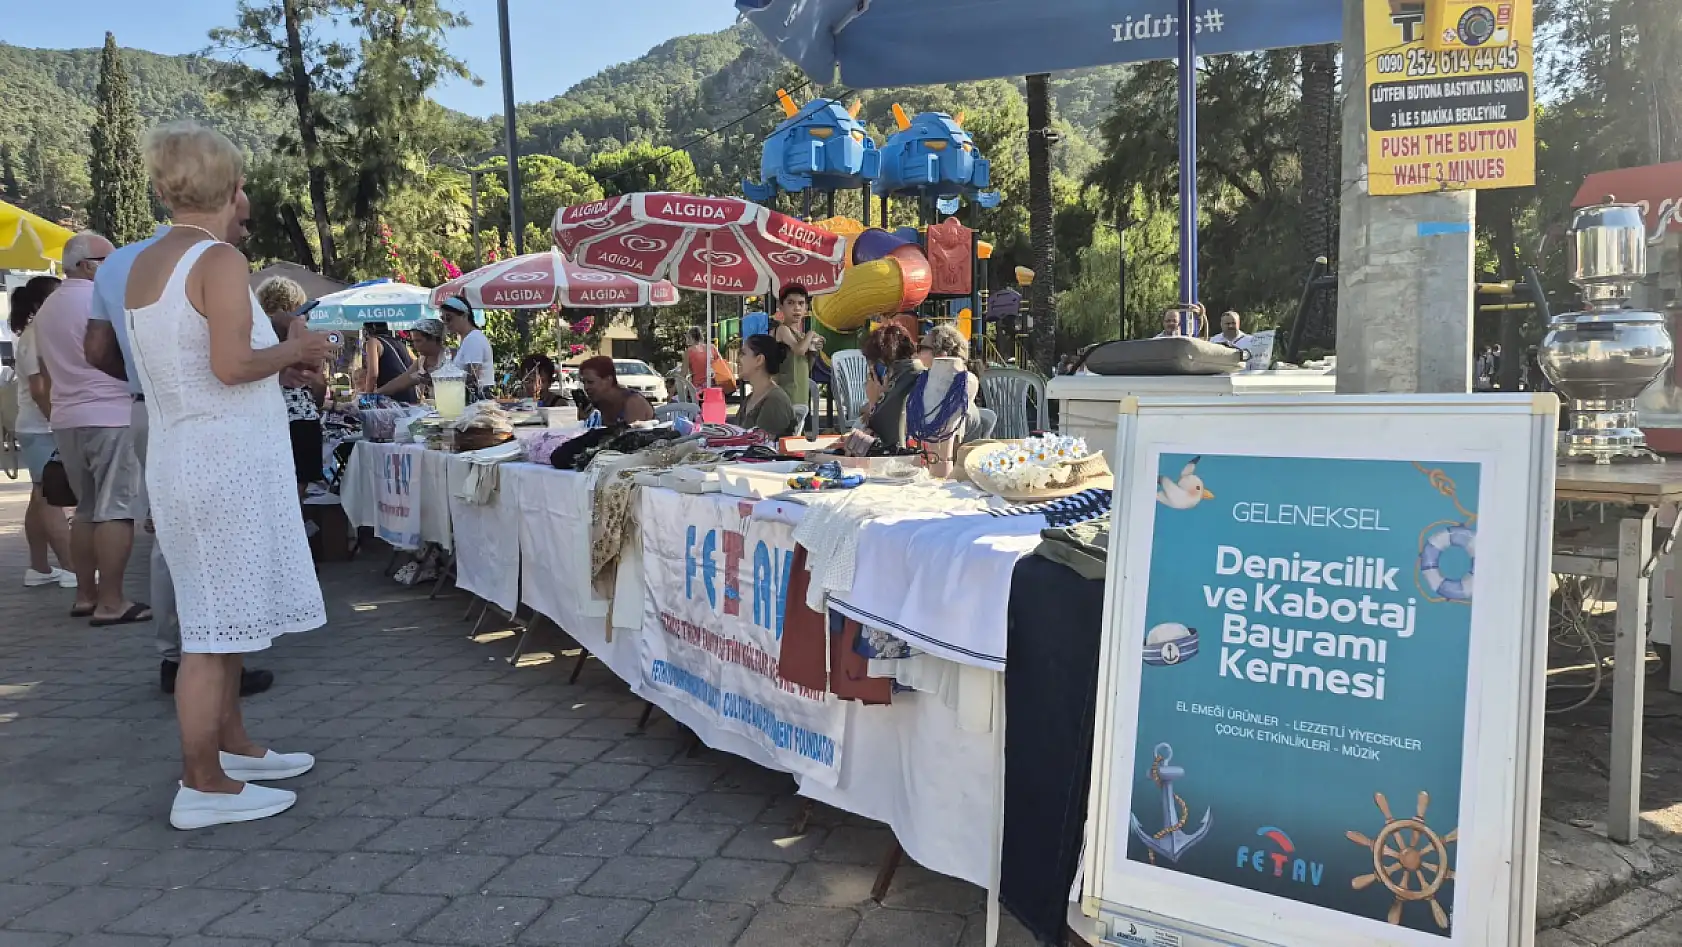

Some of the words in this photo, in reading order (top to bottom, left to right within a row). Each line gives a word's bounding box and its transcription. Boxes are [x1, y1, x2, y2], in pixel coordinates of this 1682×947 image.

[1377, 54, 1403, 74] 0090
[1407, 48, 1437, 76] 252
[1441, 49, 1470, 73] 614
[1474, 48, 1494, 70] 44
[1497, 46, 1518, 69] 45
[1372, 84, 1405, 102] LÜTFEN
[1406, 85, 1443, 100] BUTONA
[1444, 80, 1493, 98] BASTIKTAN
[1494, 77, 1524, 94] SONRA
[1391, 113, 1397, 128] 3
[1414, 112, 1419, 126] 5
[1421, 105, 1454, 125] DAKİKA
[1456, 101, 1507, 122] BEKLEYİNİZ
[1381, 135, 1420, 158] PUSH
[1425, 132, 1454, 155] THE
[1458, 128, 1517, 153] BUTTON
[1394, 162, 1431, 185] WAIT
[1435, 162, 1444, 182] 3
[1448, 158, 1505, 181] MINUES
[1232, 501, 1390, 531] GELENEKSEL
[1215, 544, 1400, 592] Denizcilik
[1203, 584, 1248, 611] ve
[1254, 582, 1417, 638] Kabotaj
[1222, 613, 1388, 664] Bayramı
[1219, 646, 1386, 700] Kermesi
[1176, 700, 1189, 712] EL
[1191, 703, 1225, 718] EMEĞİ
[1227, 707, 1279, 727] ÜRÜNLER
[1293, 719, 1346, 738] LEZZETLİ
[1348, 727, 1422, 751] YİYECEKLER
[1214, 722, 1255, 739] ÇOCUK
[1256, 730, 1331, 752] ETKİNLİKLERİ
[1341, 744, 1380, 761] MÜZİK
[1236, 845, 1324, 886] FETAV
